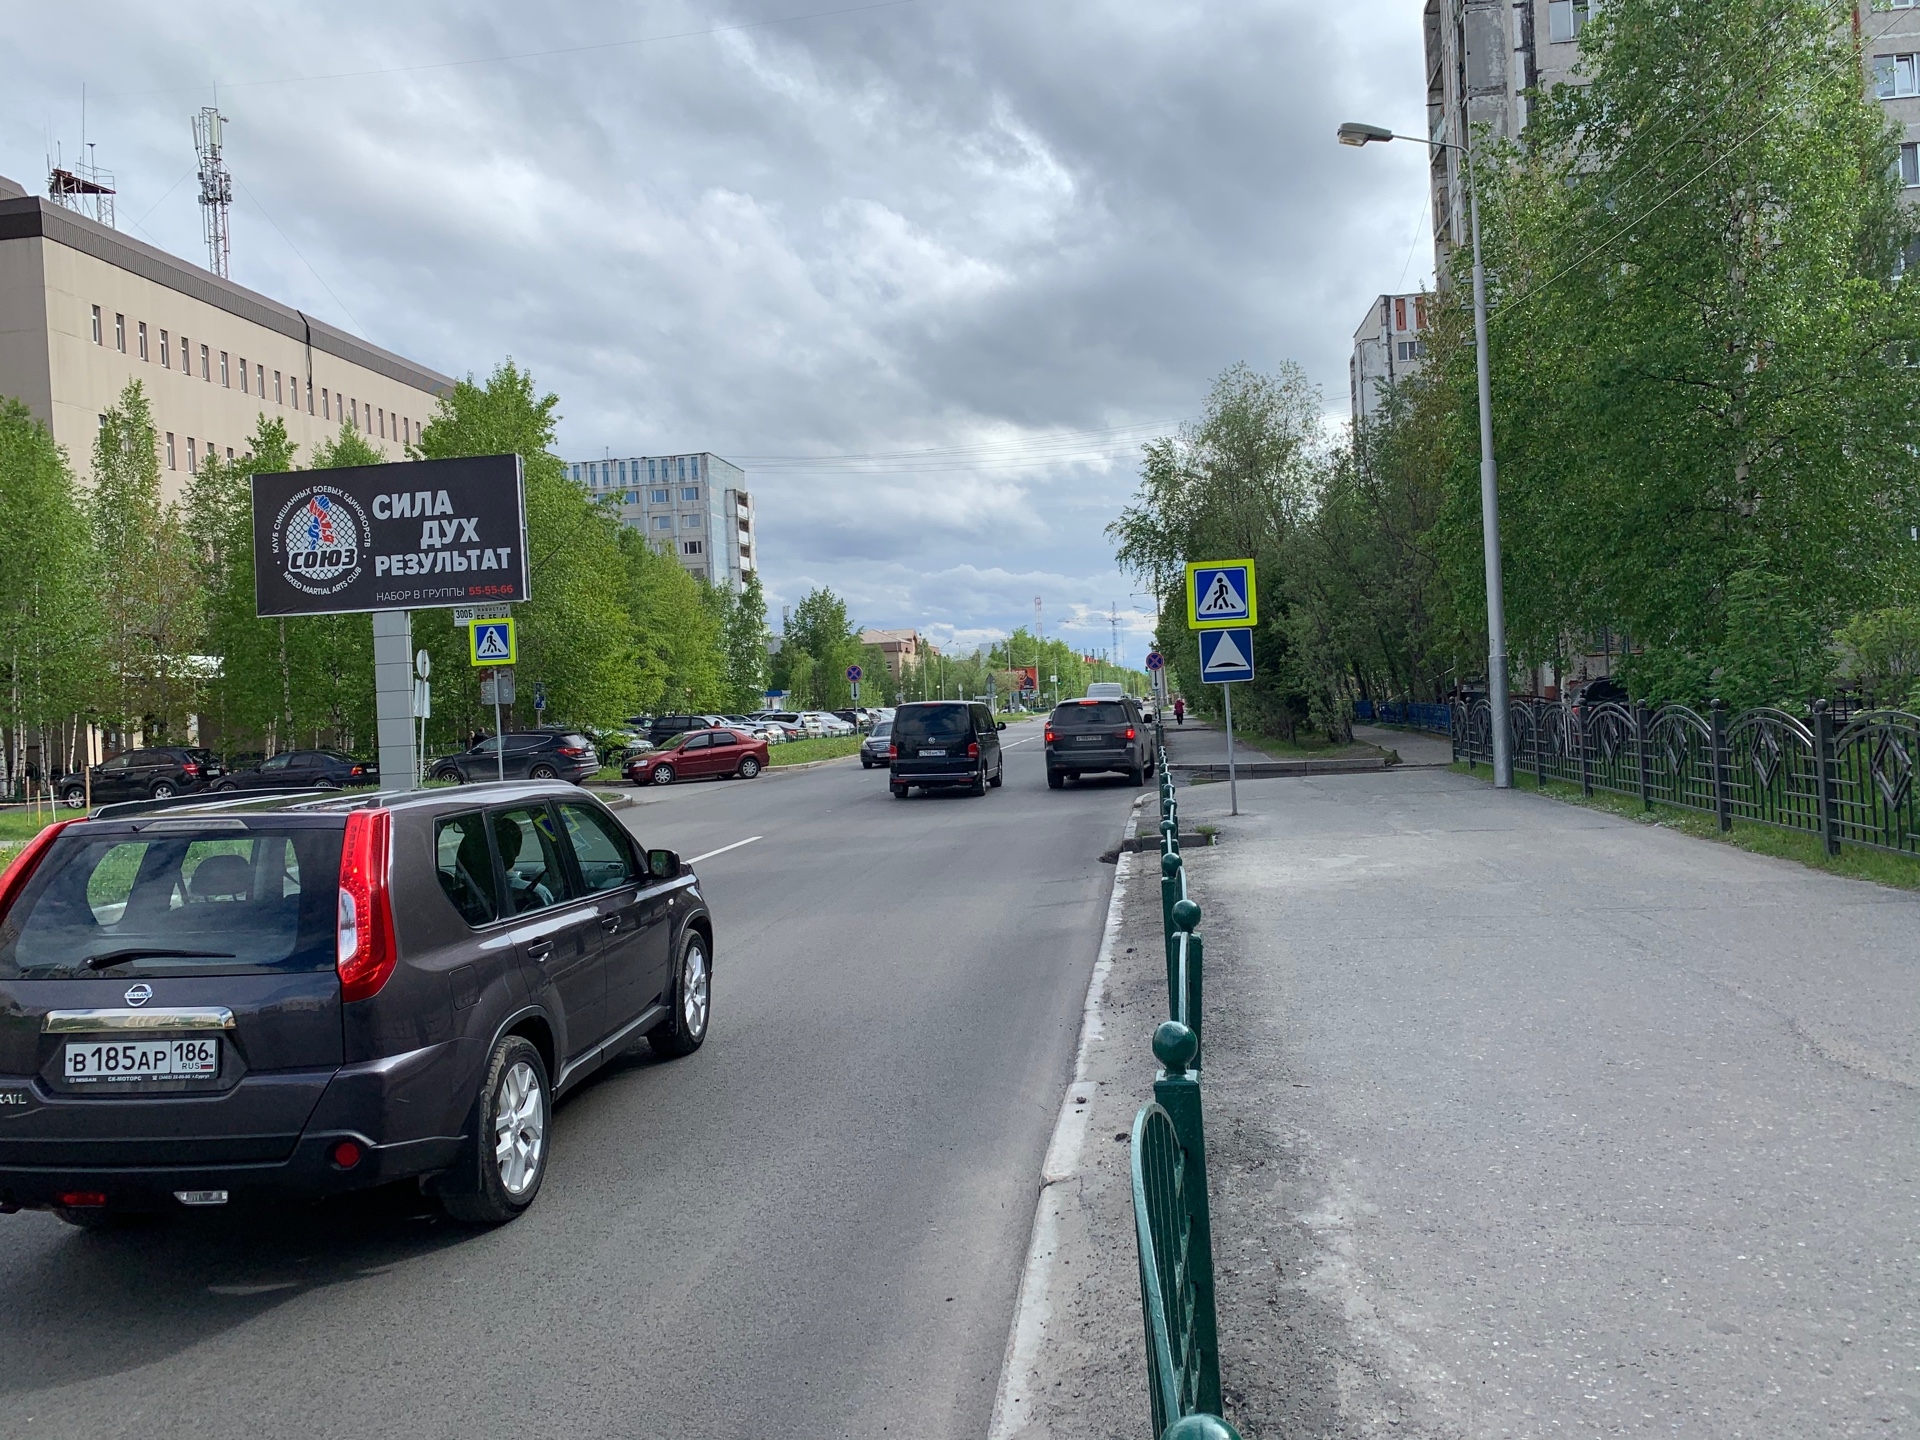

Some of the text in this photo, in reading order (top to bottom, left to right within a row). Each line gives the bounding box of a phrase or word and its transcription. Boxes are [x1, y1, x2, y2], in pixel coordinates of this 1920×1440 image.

[372, 490, 454, 520] СИЛА
[271, 485, 371, 554] КЛУБ СМЕШАННЫХ БОЕВЫХ ЕДИНОБОРСТВ
[420, 517, 480, 550] ДУХ
[289, 547, 357, 571] СОЮЗ
[374, 547, 512, 577] РЕЗУЛЬТАТ
[282, 566, 362, 595] MIXED MARTIAL ARTS CLUB
[376, 584, 514, 601] НАБОР В ГРУППЫ 55-55-66
[73, 1046, 167, 1072] В185АР
[174, 1042, 209, 1062] 186
[181, 1062, 200, 1070] RUS
